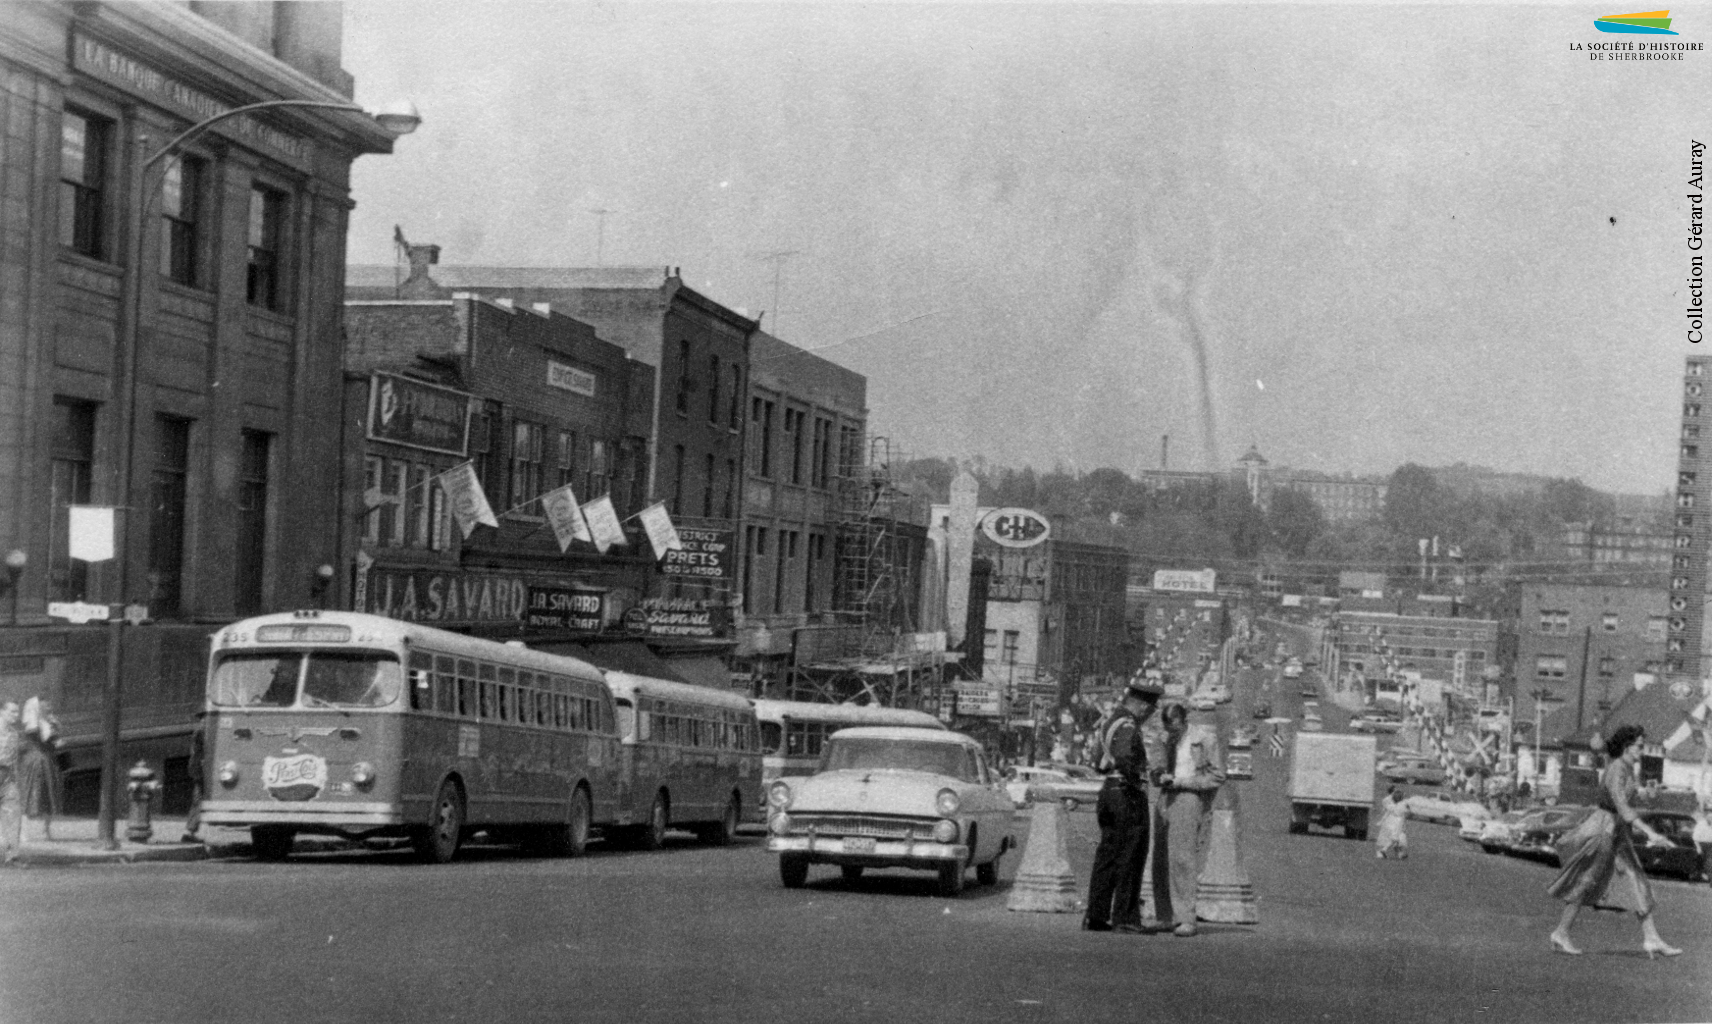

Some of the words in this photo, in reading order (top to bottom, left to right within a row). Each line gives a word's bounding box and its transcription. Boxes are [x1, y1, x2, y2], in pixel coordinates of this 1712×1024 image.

[83, 38, 104, 66] LA
[108, 52, 161, 92] BANQUE
[667, 551, 719, 566] PRETS
[427, 576, 524, 620] SAVARD
[549, 593, 601, 613] SAVARD
[221, 632, 247, 643] 235
